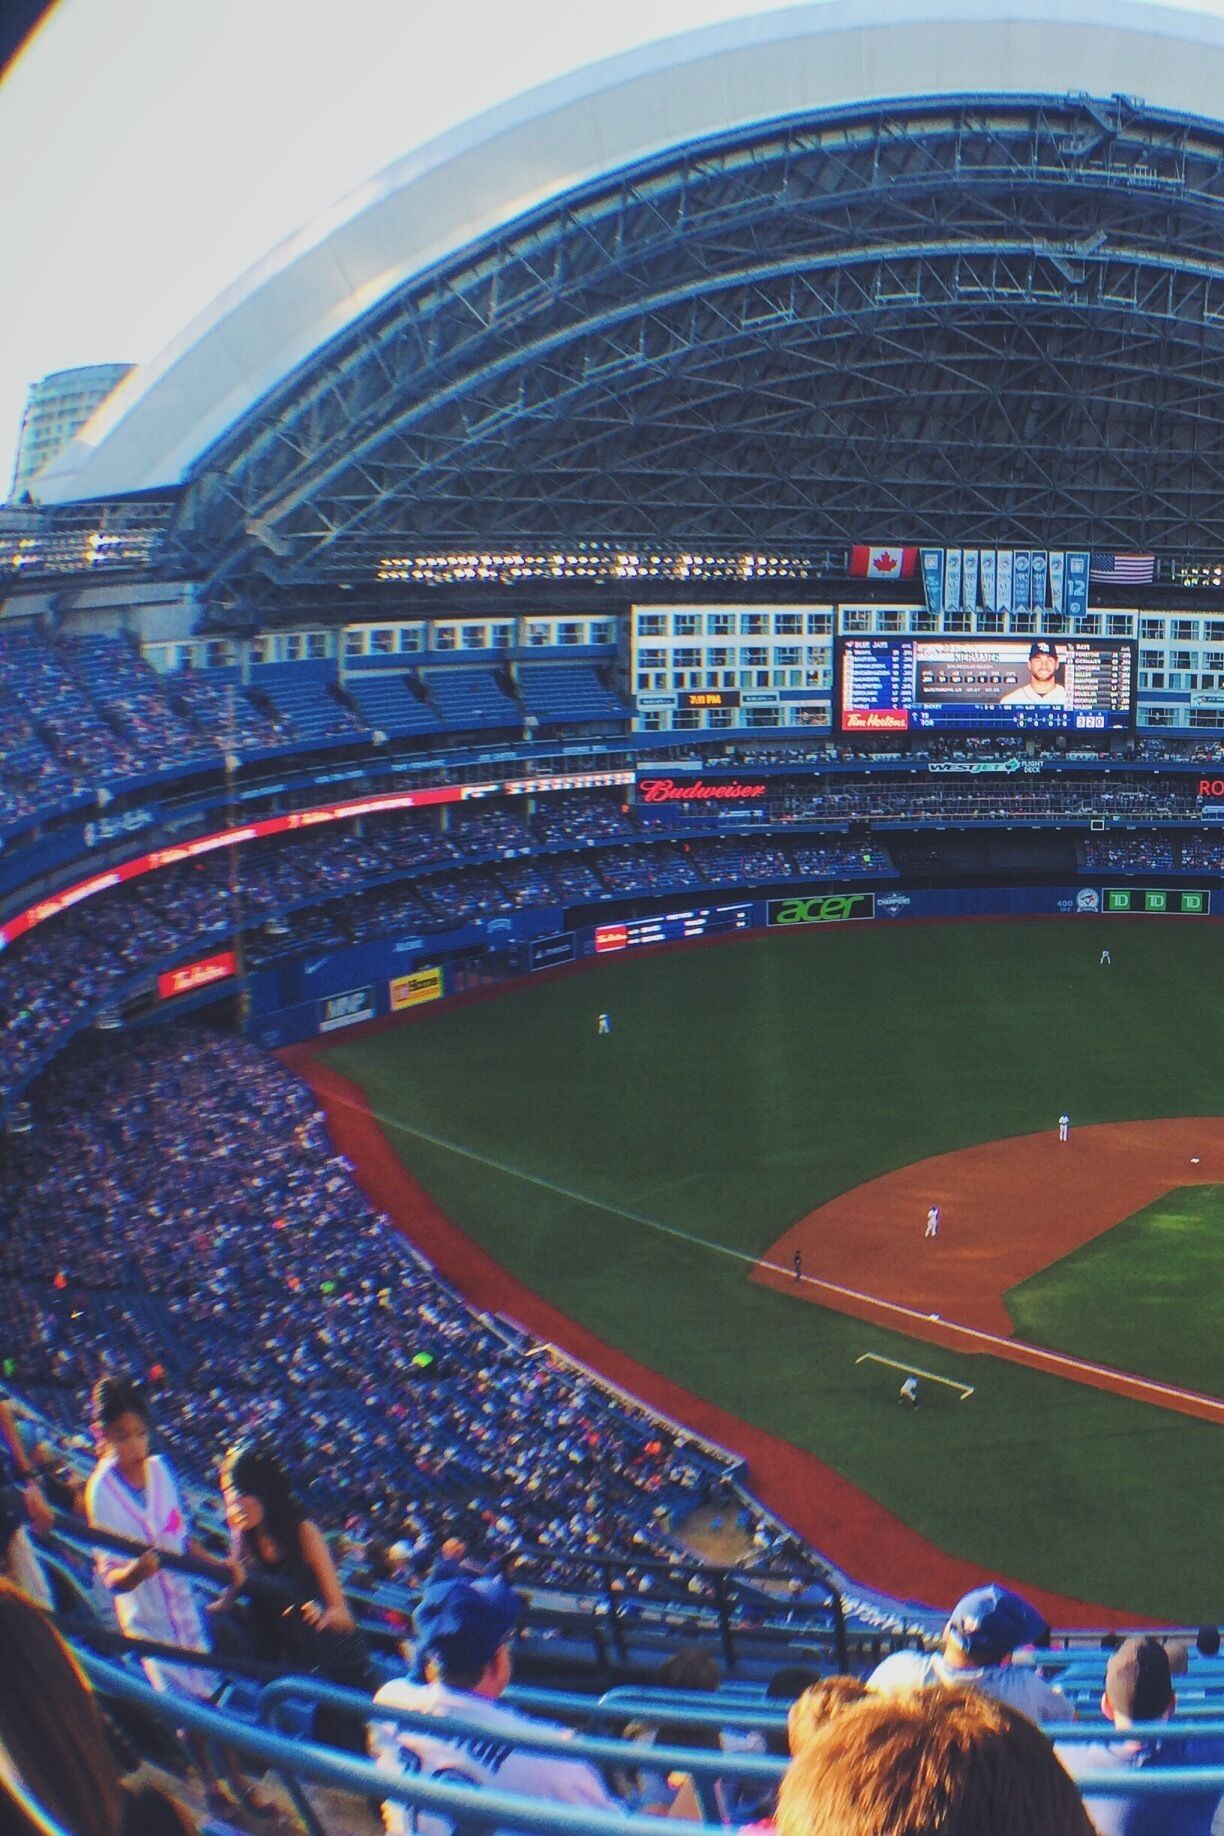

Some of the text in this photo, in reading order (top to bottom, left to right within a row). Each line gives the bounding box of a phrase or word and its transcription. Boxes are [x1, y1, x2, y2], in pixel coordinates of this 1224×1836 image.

[1068, 580, 1085, 597] 12
[847, 713, 907, 728] Tim Hortons
[928, 762, 1005, 774] WESTJET
[1024, 766, 1041, 774] DECK
[639, 779, 766, 802] Budweiser
[1111, 894, 1129, 907] TD
[1147, 894, 1165, 907] TD
[1184, 895, 1201, 908] TD
[776, 895, 865, 924] acer
